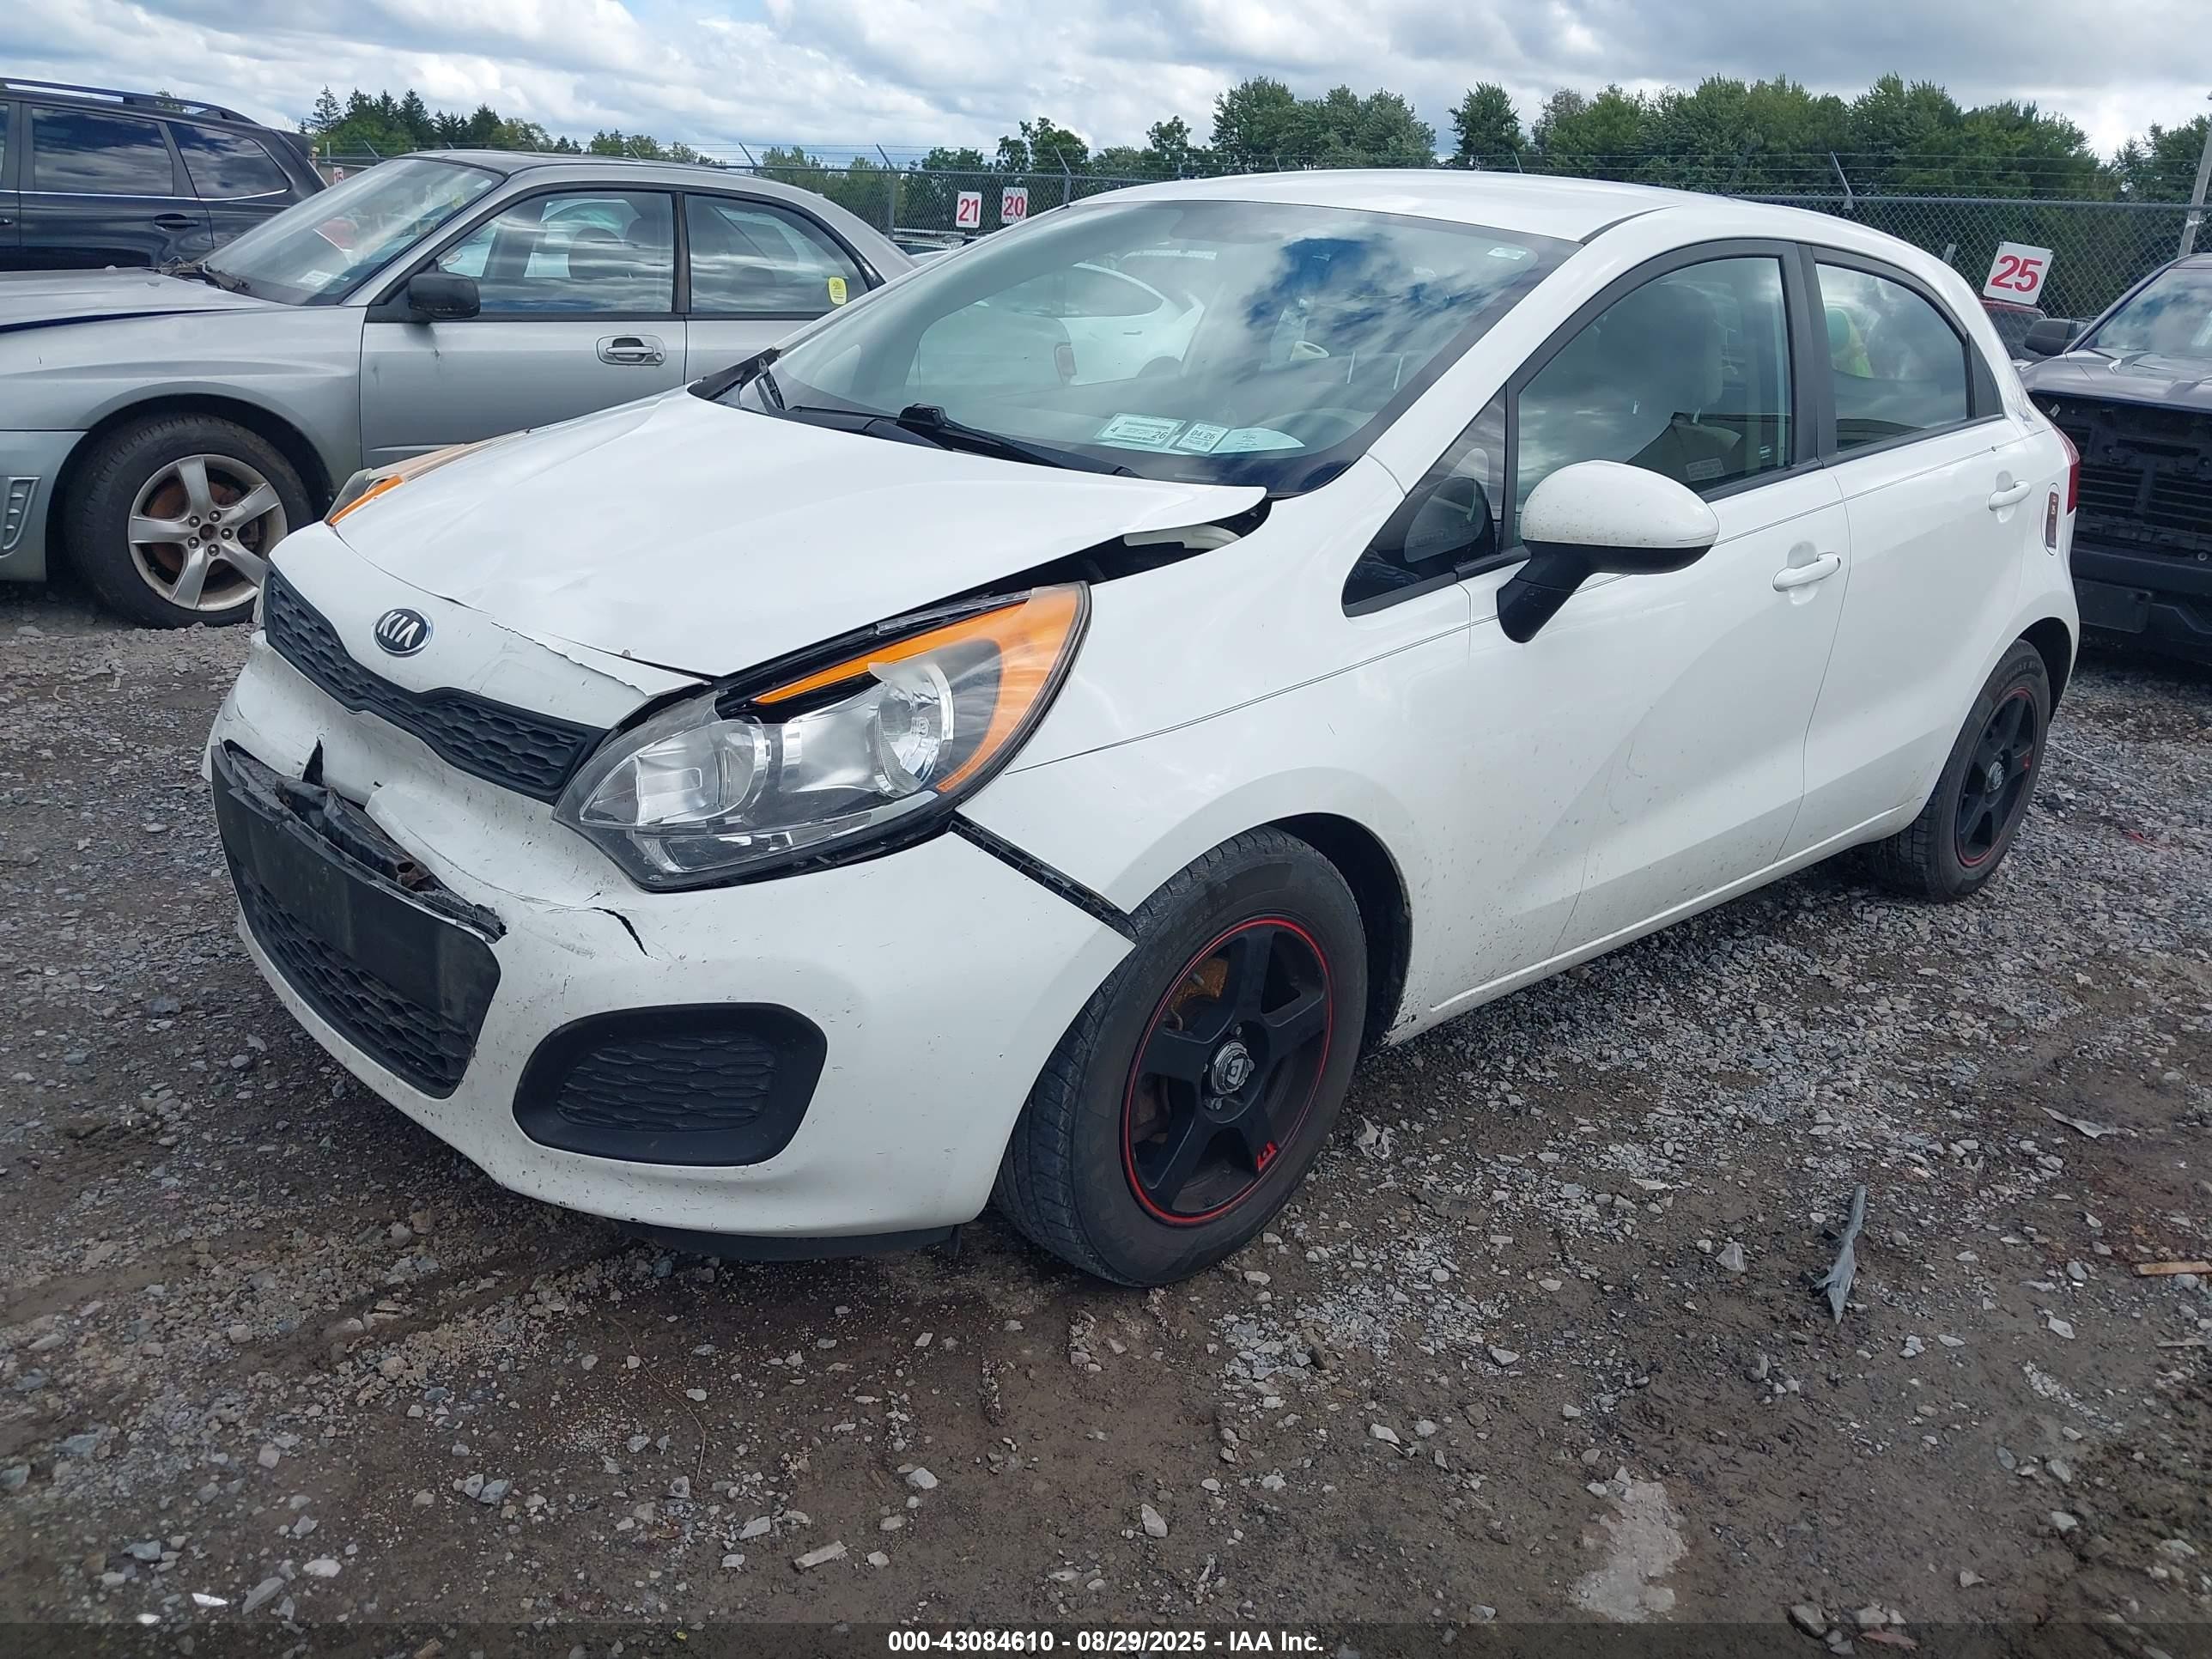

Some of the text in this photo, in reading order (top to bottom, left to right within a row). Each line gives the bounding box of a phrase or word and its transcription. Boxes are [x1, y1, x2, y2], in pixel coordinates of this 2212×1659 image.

[958, 198, 979, 222] 21
[1003, 196, 1025, 216] 20
[1991, 255, 2043, 292] 25
[378, 611, 420, 648] KIA
